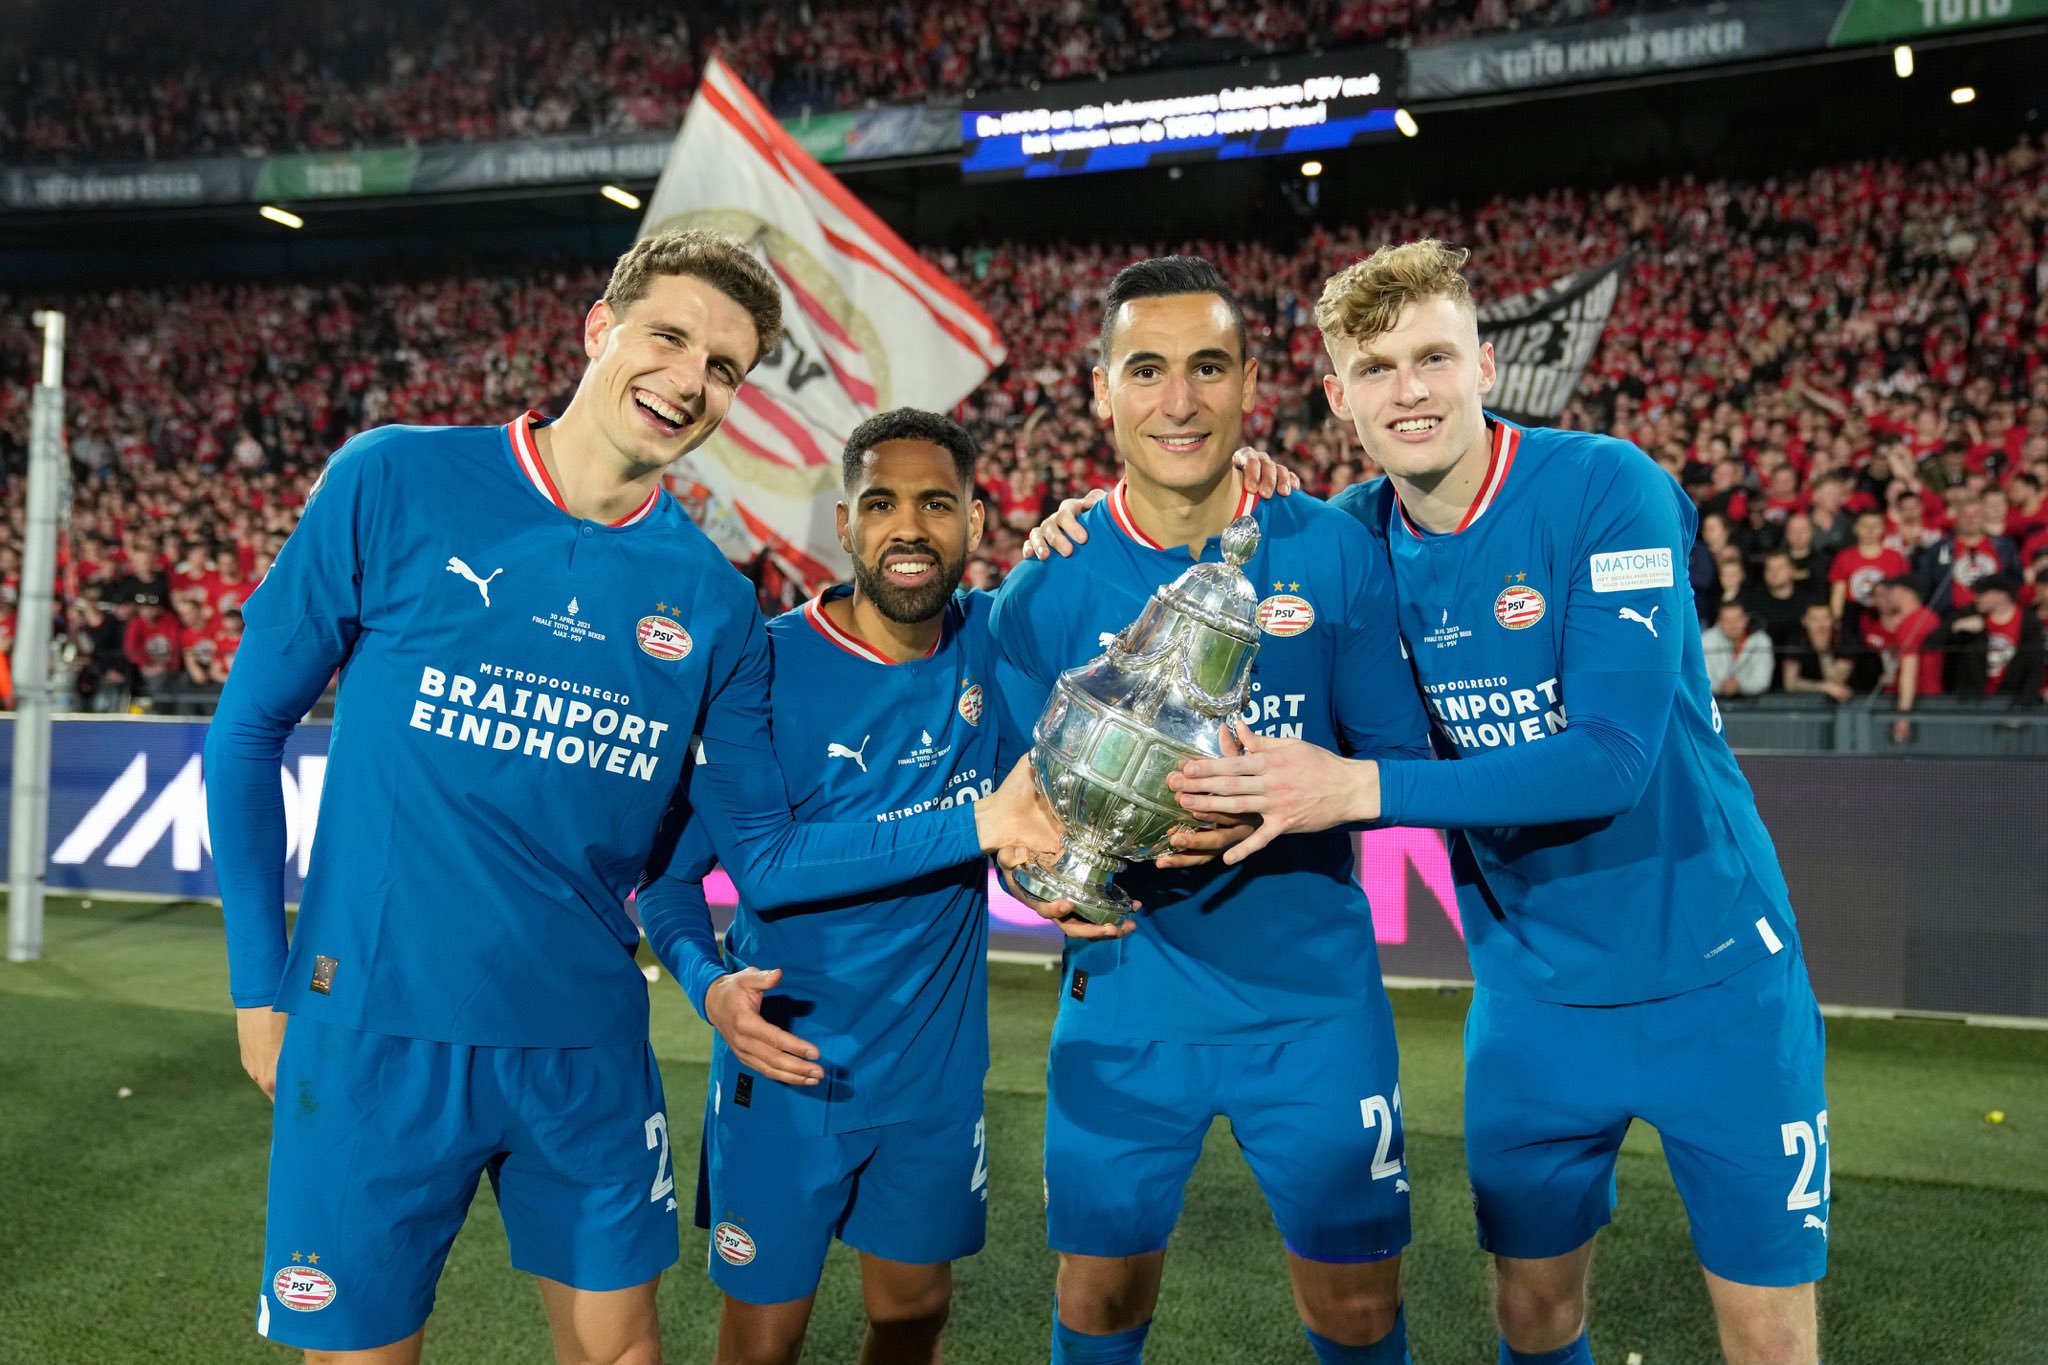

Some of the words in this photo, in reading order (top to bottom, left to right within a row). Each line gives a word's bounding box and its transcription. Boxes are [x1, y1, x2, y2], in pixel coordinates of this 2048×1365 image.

[1595, 553, 1669, 573] MATCHIS
[1508, 600, 1525, 611] PSV
[1274, 609, 1296, 618] PSV
[653, 630, 674, 643] PSV
[479, 663, 631, 706] METROPOOLREGIO
[419, 666, 669, 749] BRAINPORT
[409, 699, 659, 782] EINDHOVEN
[725, 1236, 740, 1247] PSV
[291, 1281, 315, 1292] PSV
